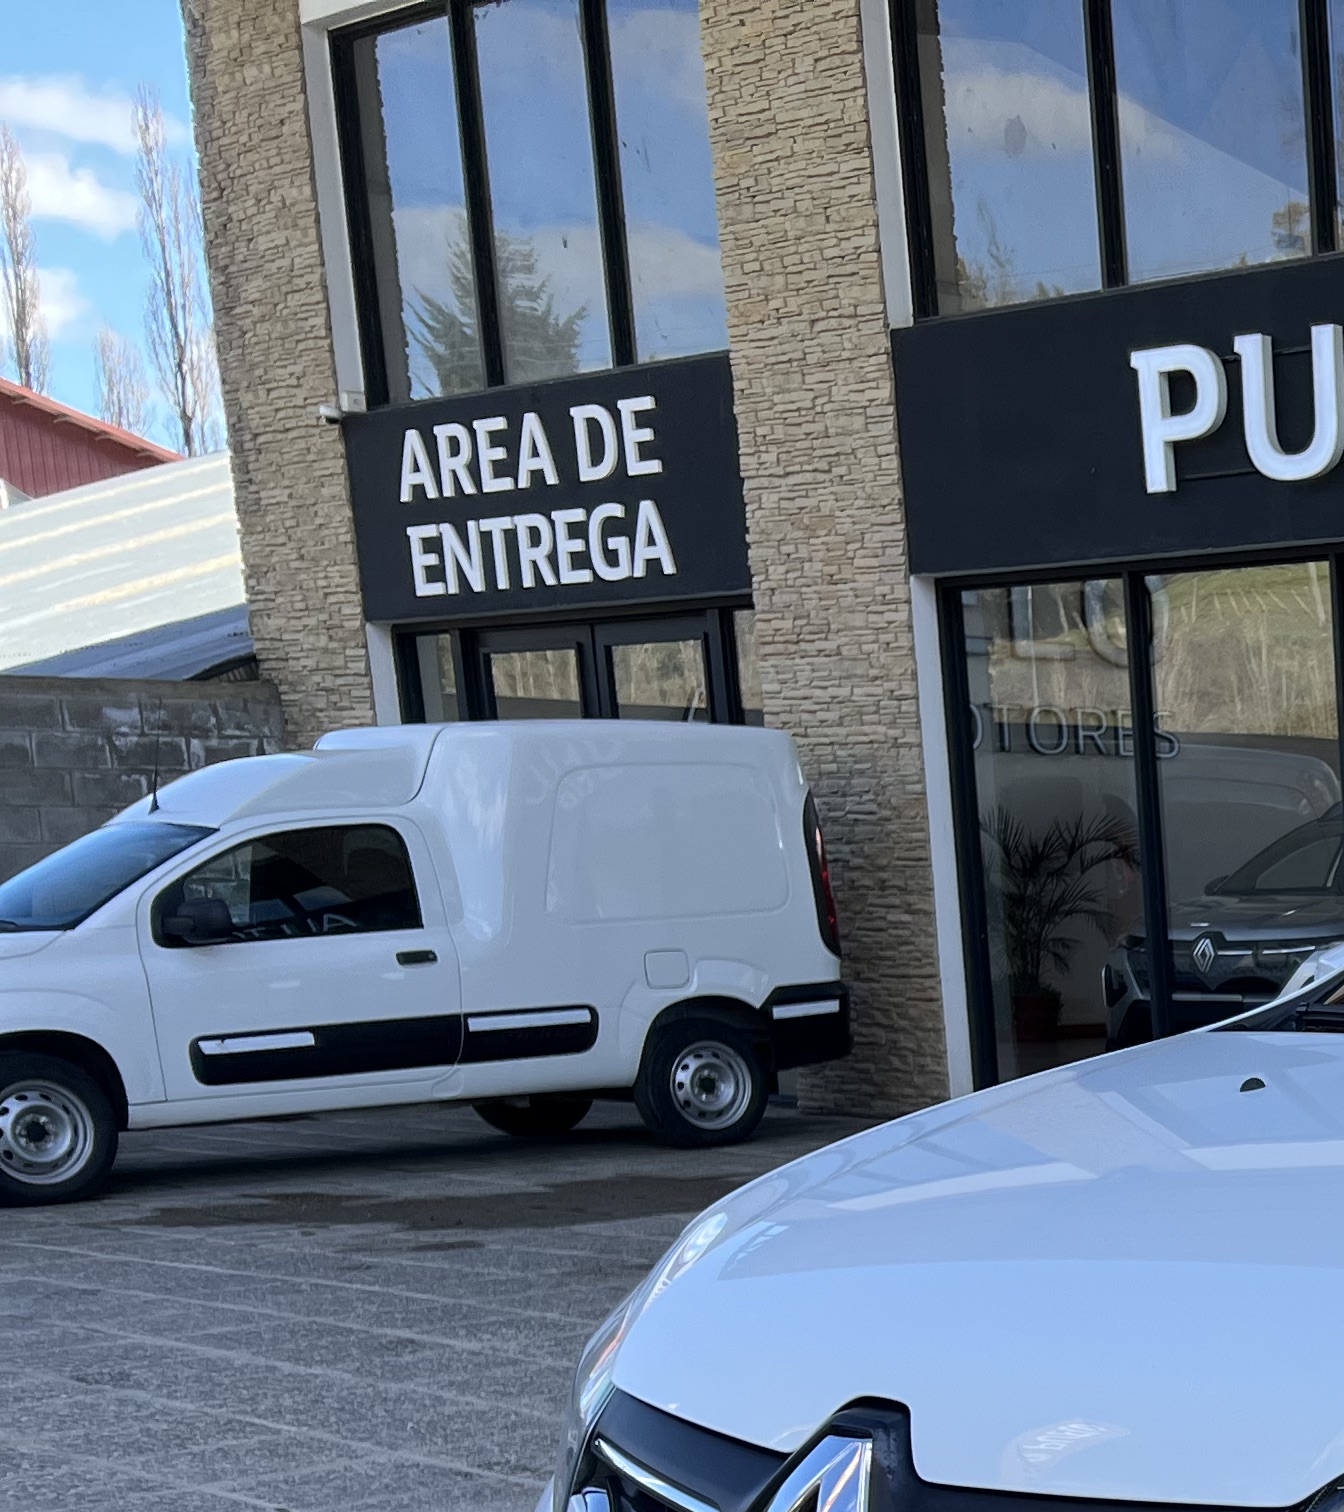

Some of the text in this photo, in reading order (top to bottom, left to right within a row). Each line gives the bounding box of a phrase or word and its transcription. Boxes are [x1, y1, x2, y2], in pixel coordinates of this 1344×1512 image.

[399, 395, 664, 503] AREA DE
[406, 499, 678, 597] ENTREGA
